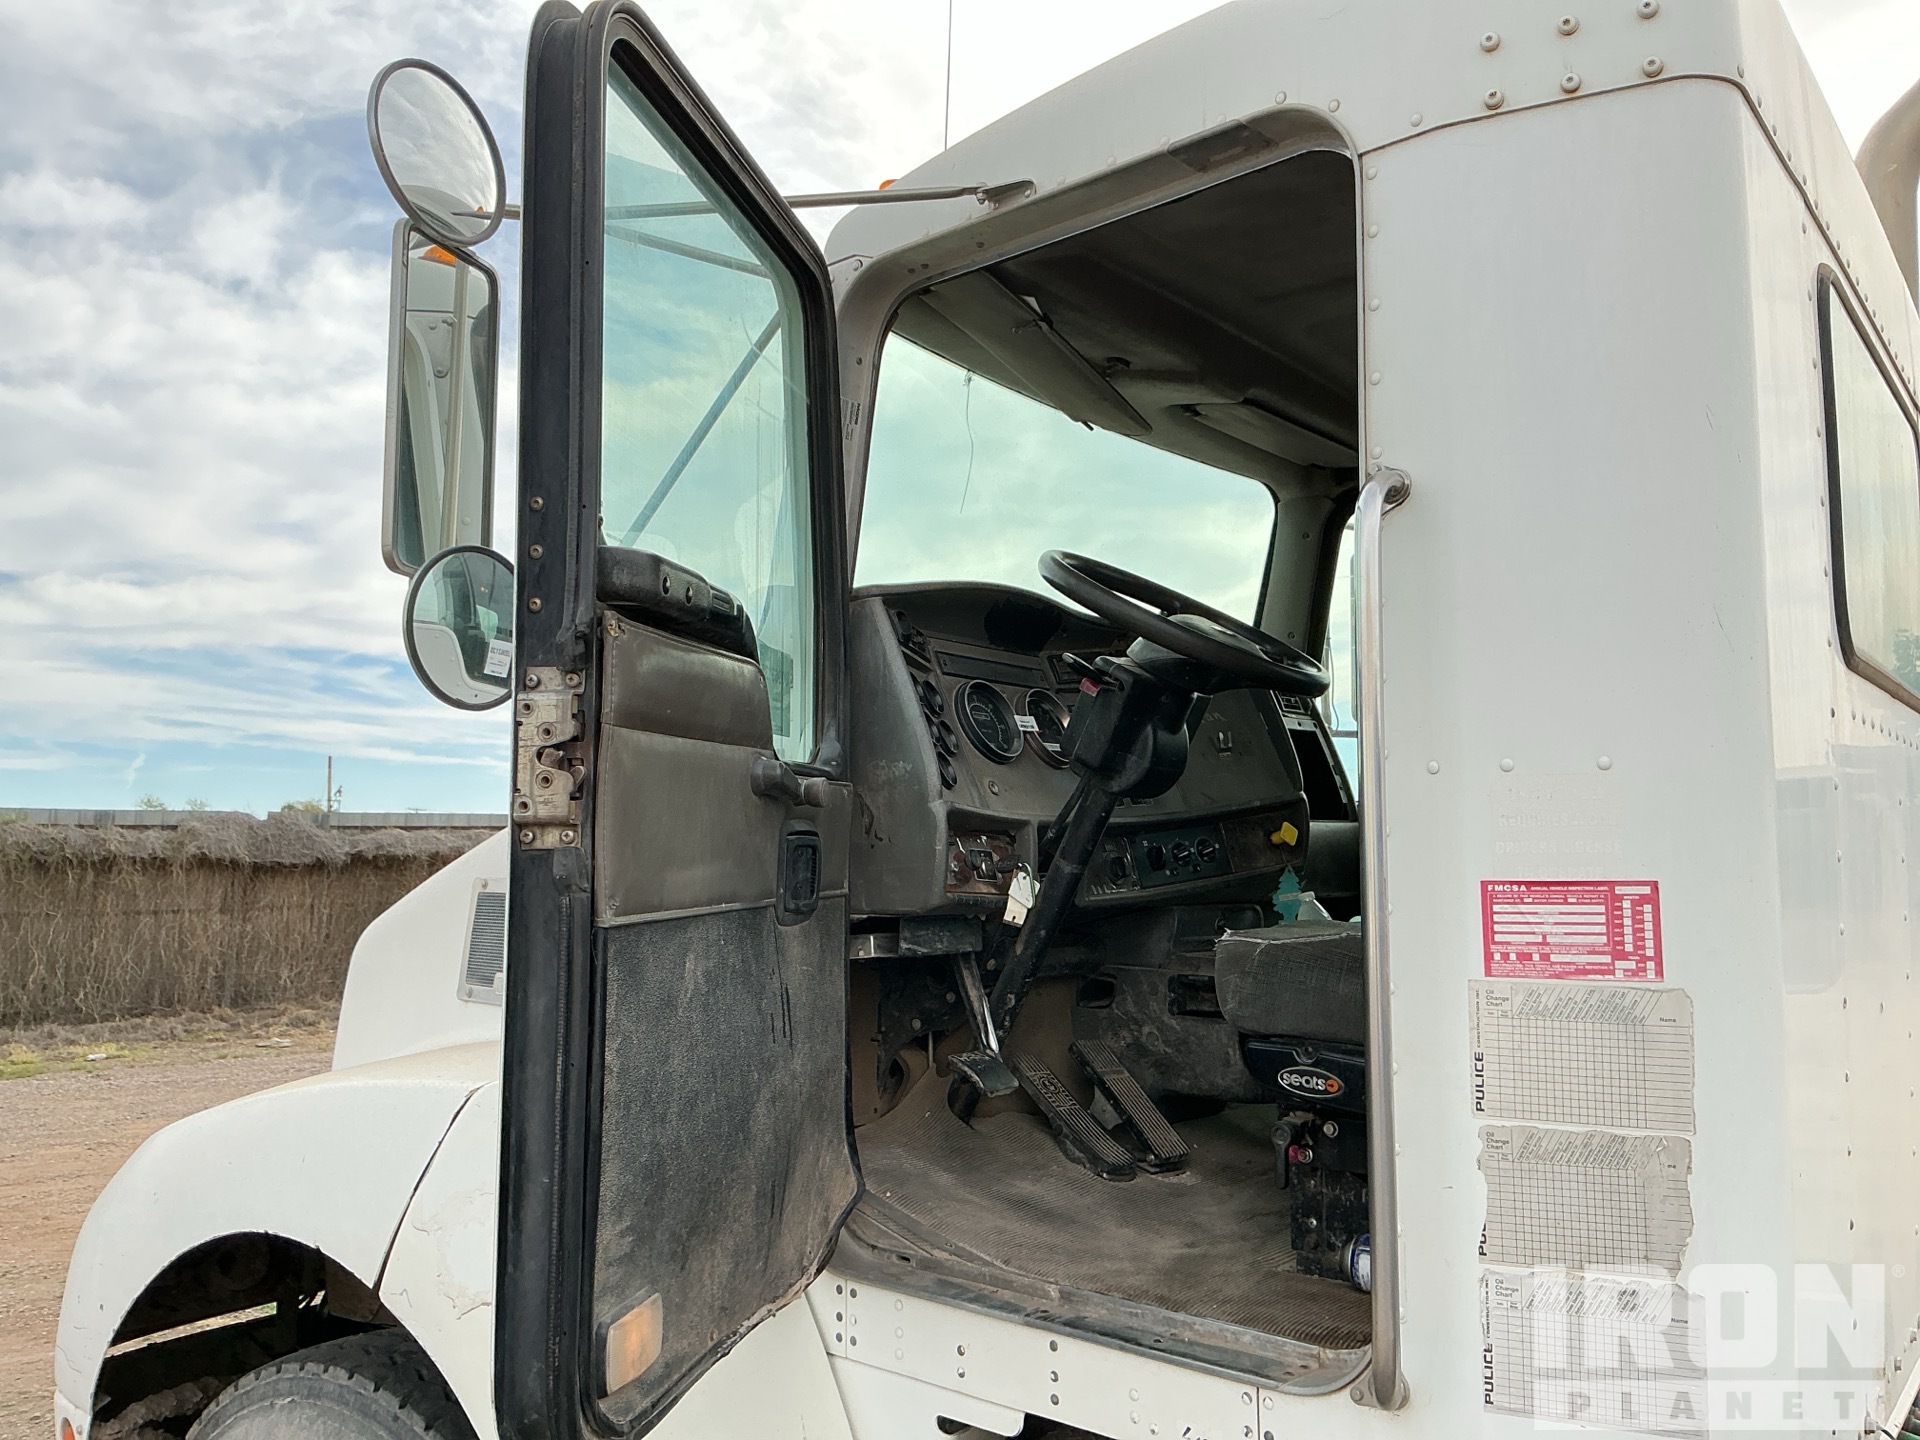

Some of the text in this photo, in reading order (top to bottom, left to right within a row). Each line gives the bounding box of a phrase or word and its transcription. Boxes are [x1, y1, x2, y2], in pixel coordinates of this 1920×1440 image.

[1282, 1072, 1326, 1090] seats
[1474, 1052, 1485, 1112] PULICE
[1495, 1285, 1519, 1293] Change
[1484, 1343, 1494, 1405] PULICE
